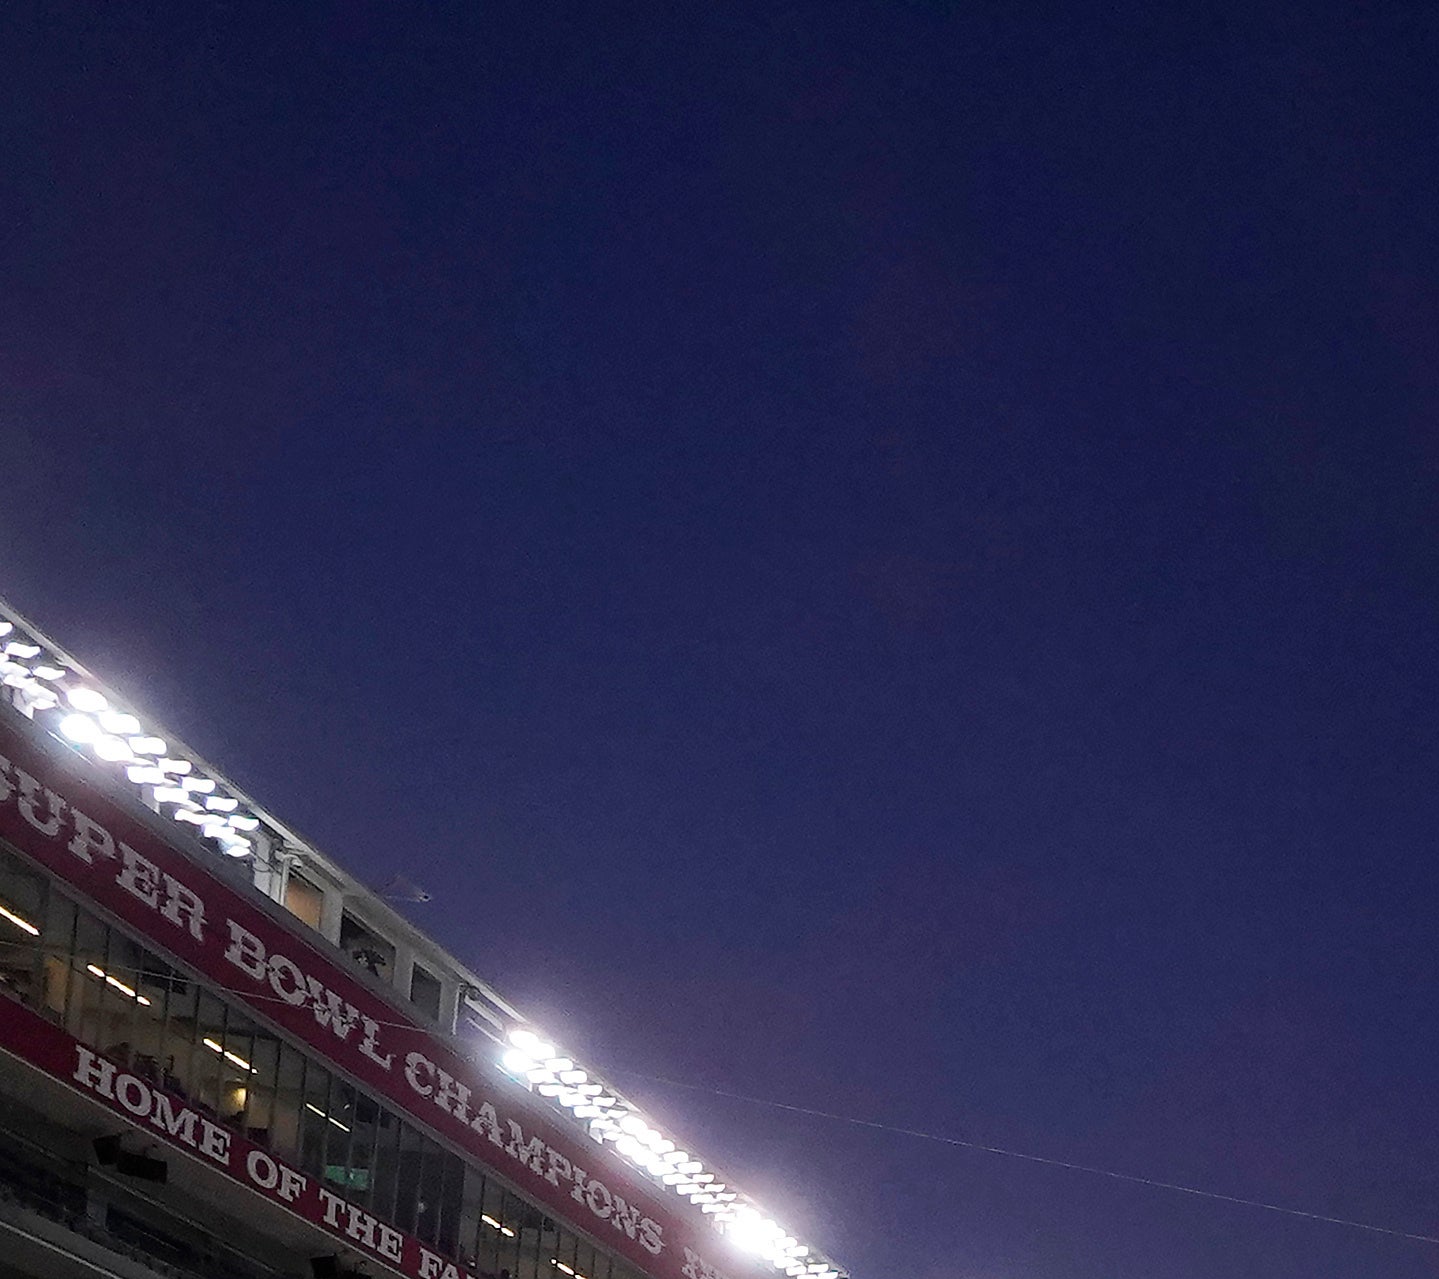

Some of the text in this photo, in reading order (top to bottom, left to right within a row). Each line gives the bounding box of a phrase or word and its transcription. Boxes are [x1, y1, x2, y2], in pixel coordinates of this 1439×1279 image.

[73, 1043, 231, 1162] HOME
[245, 1156, 308, 1204] OF
[319, 1194, 403, 1266] THE
[224, 918, 397, 1071] BOWL
[404, 1052, 664, 1255] CHAMPIONS
